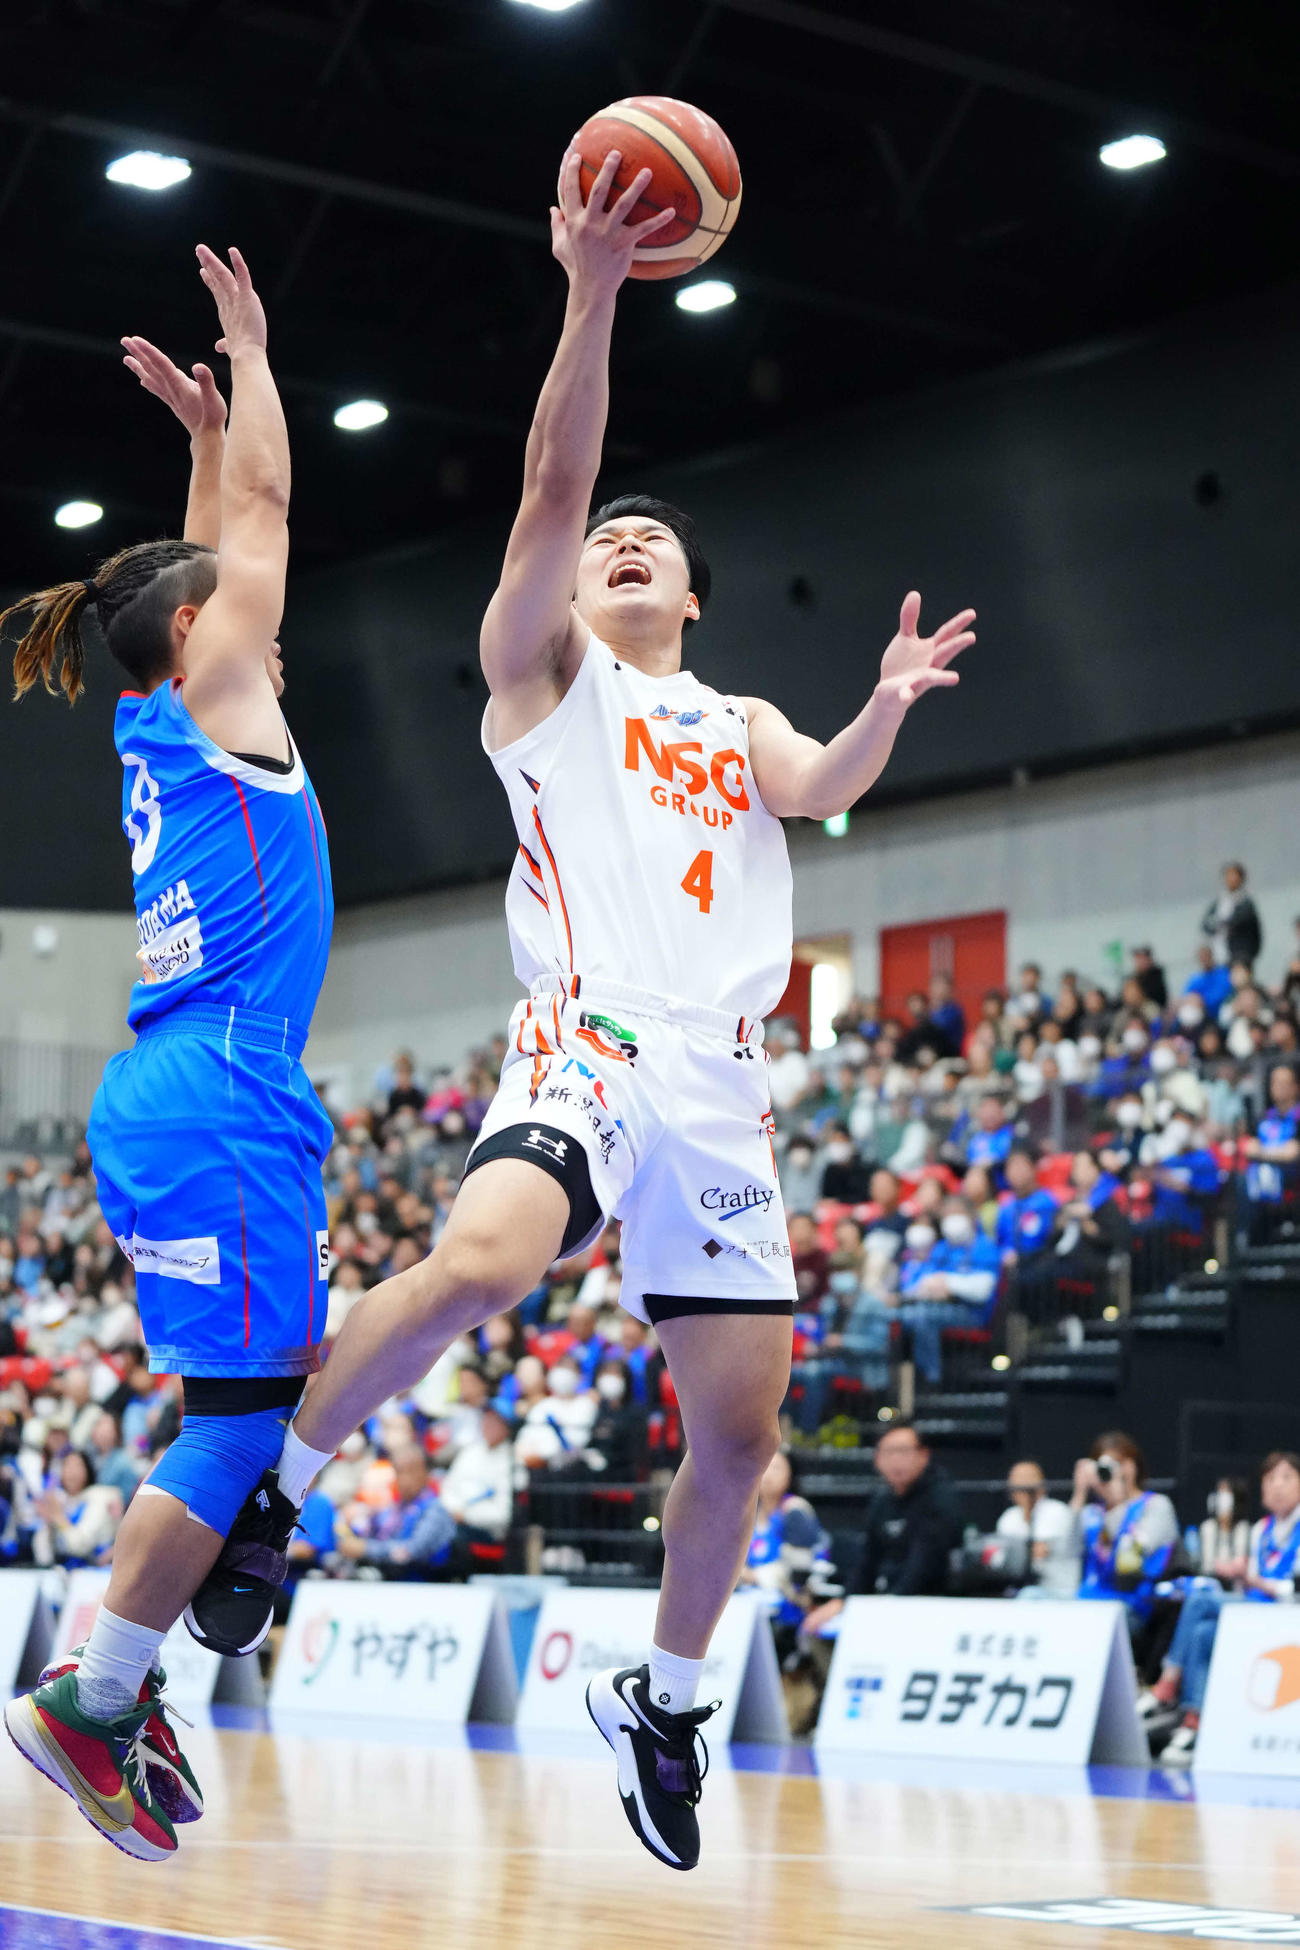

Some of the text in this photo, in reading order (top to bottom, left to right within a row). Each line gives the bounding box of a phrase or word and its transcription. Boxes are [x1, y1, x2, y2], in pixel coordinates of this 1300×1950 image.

[625, 717, 750, 811] NSG
[681, 850, 714, 914] 4
[700, 1185, 774, 1212] Crafty
[352, 1622, 459, 1683] やずや
[899, 1670, 1074, 1730] タチカワ
